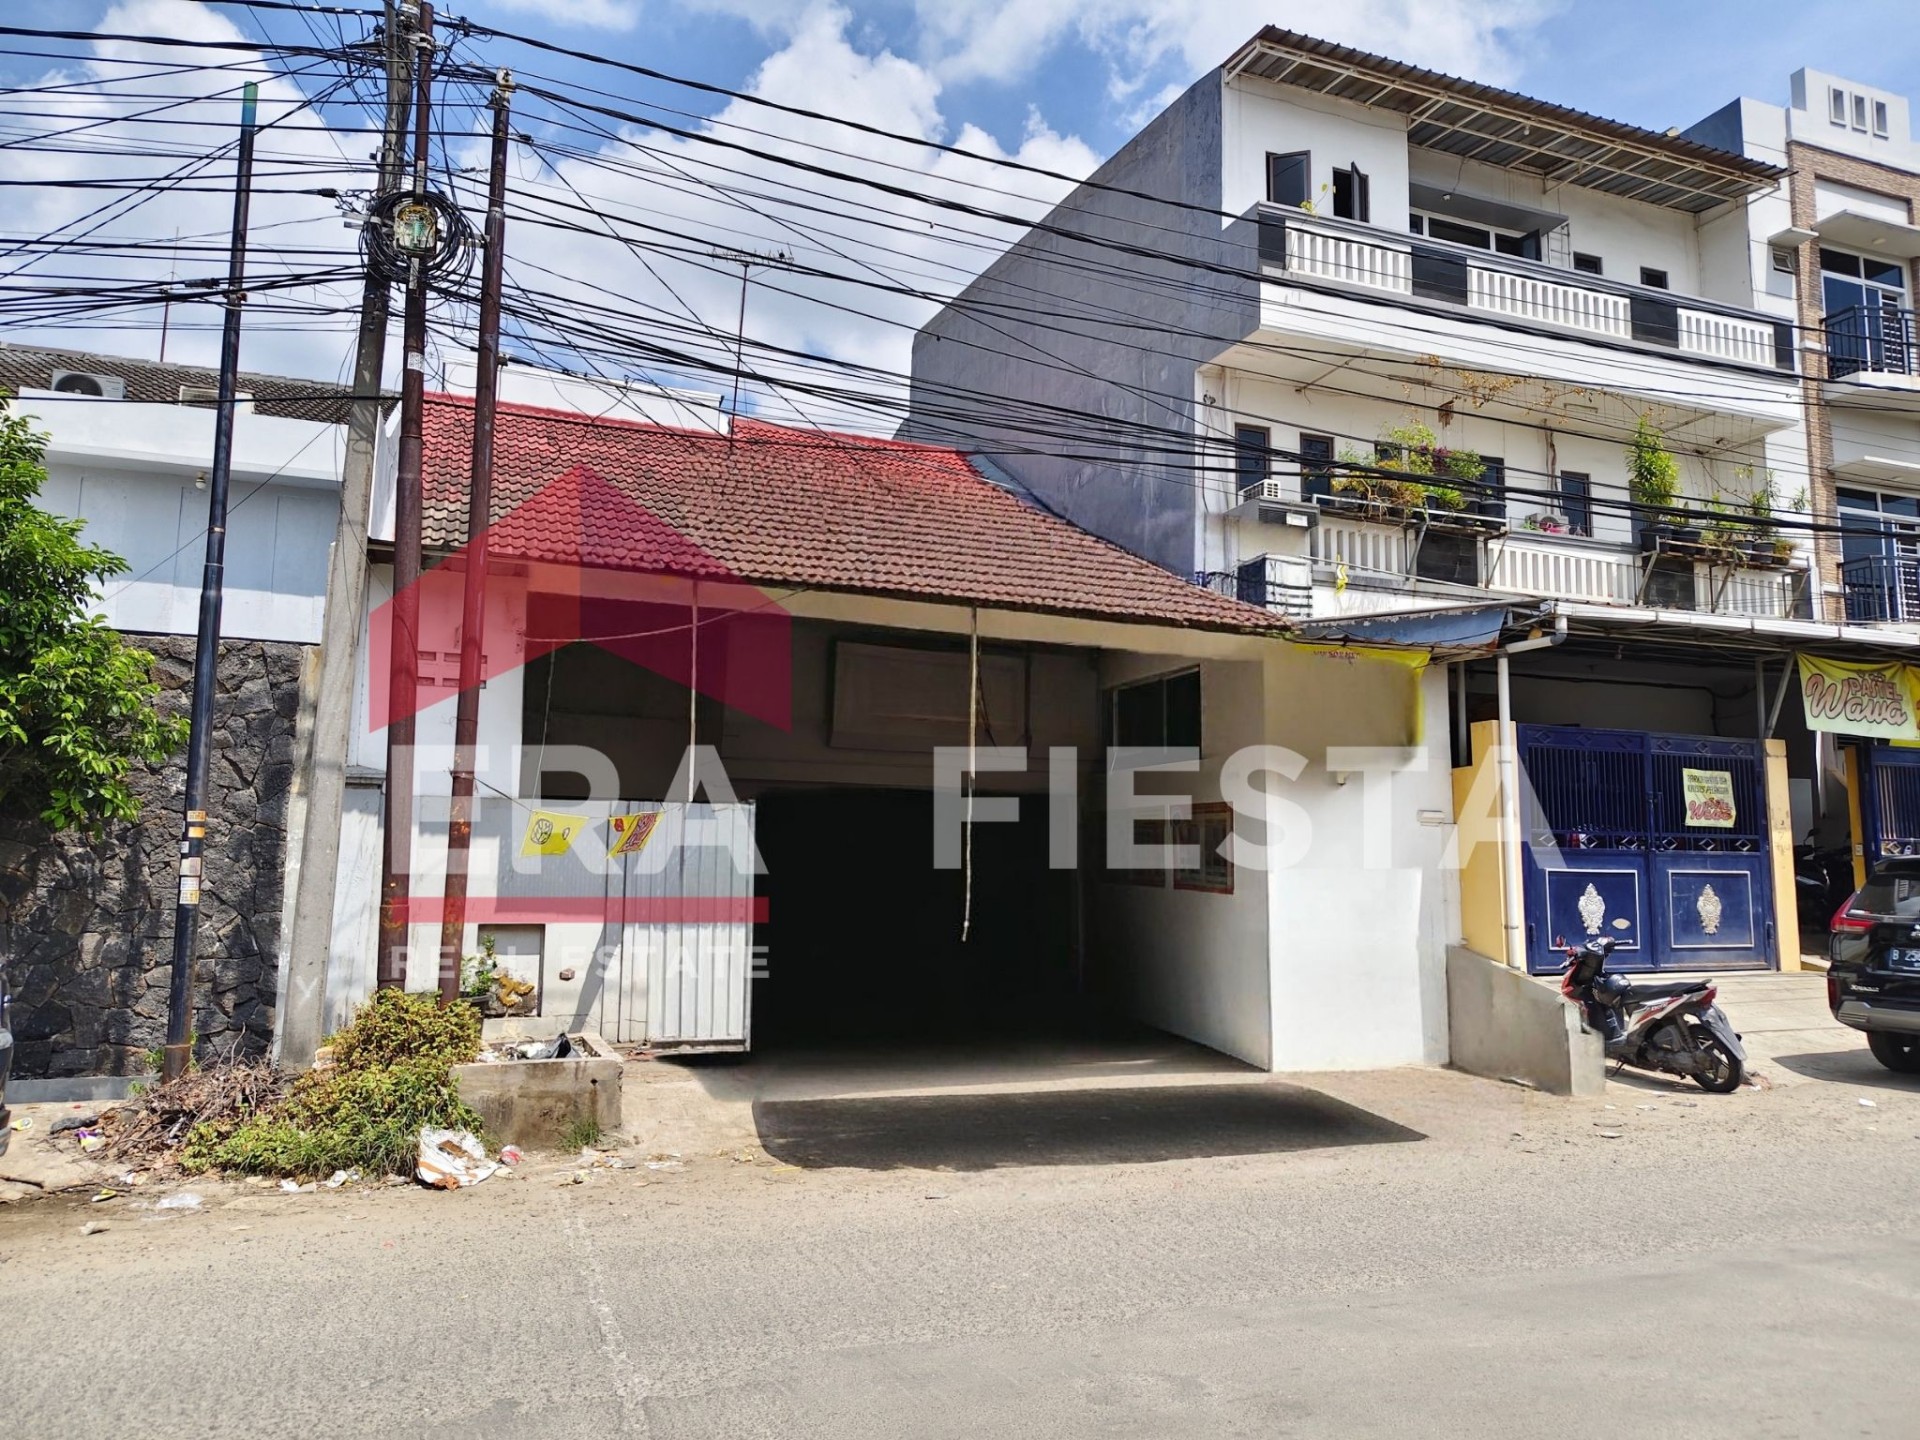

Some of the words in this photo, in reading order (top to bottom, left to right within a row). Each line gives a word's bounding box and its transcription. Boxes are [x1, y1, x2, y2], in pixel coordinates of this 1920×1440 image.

[1805, 673, 1908, 726] Wawa
[1848, 677, 1903, 700] PASTEL
[1892, 949, 1900, 960] B
